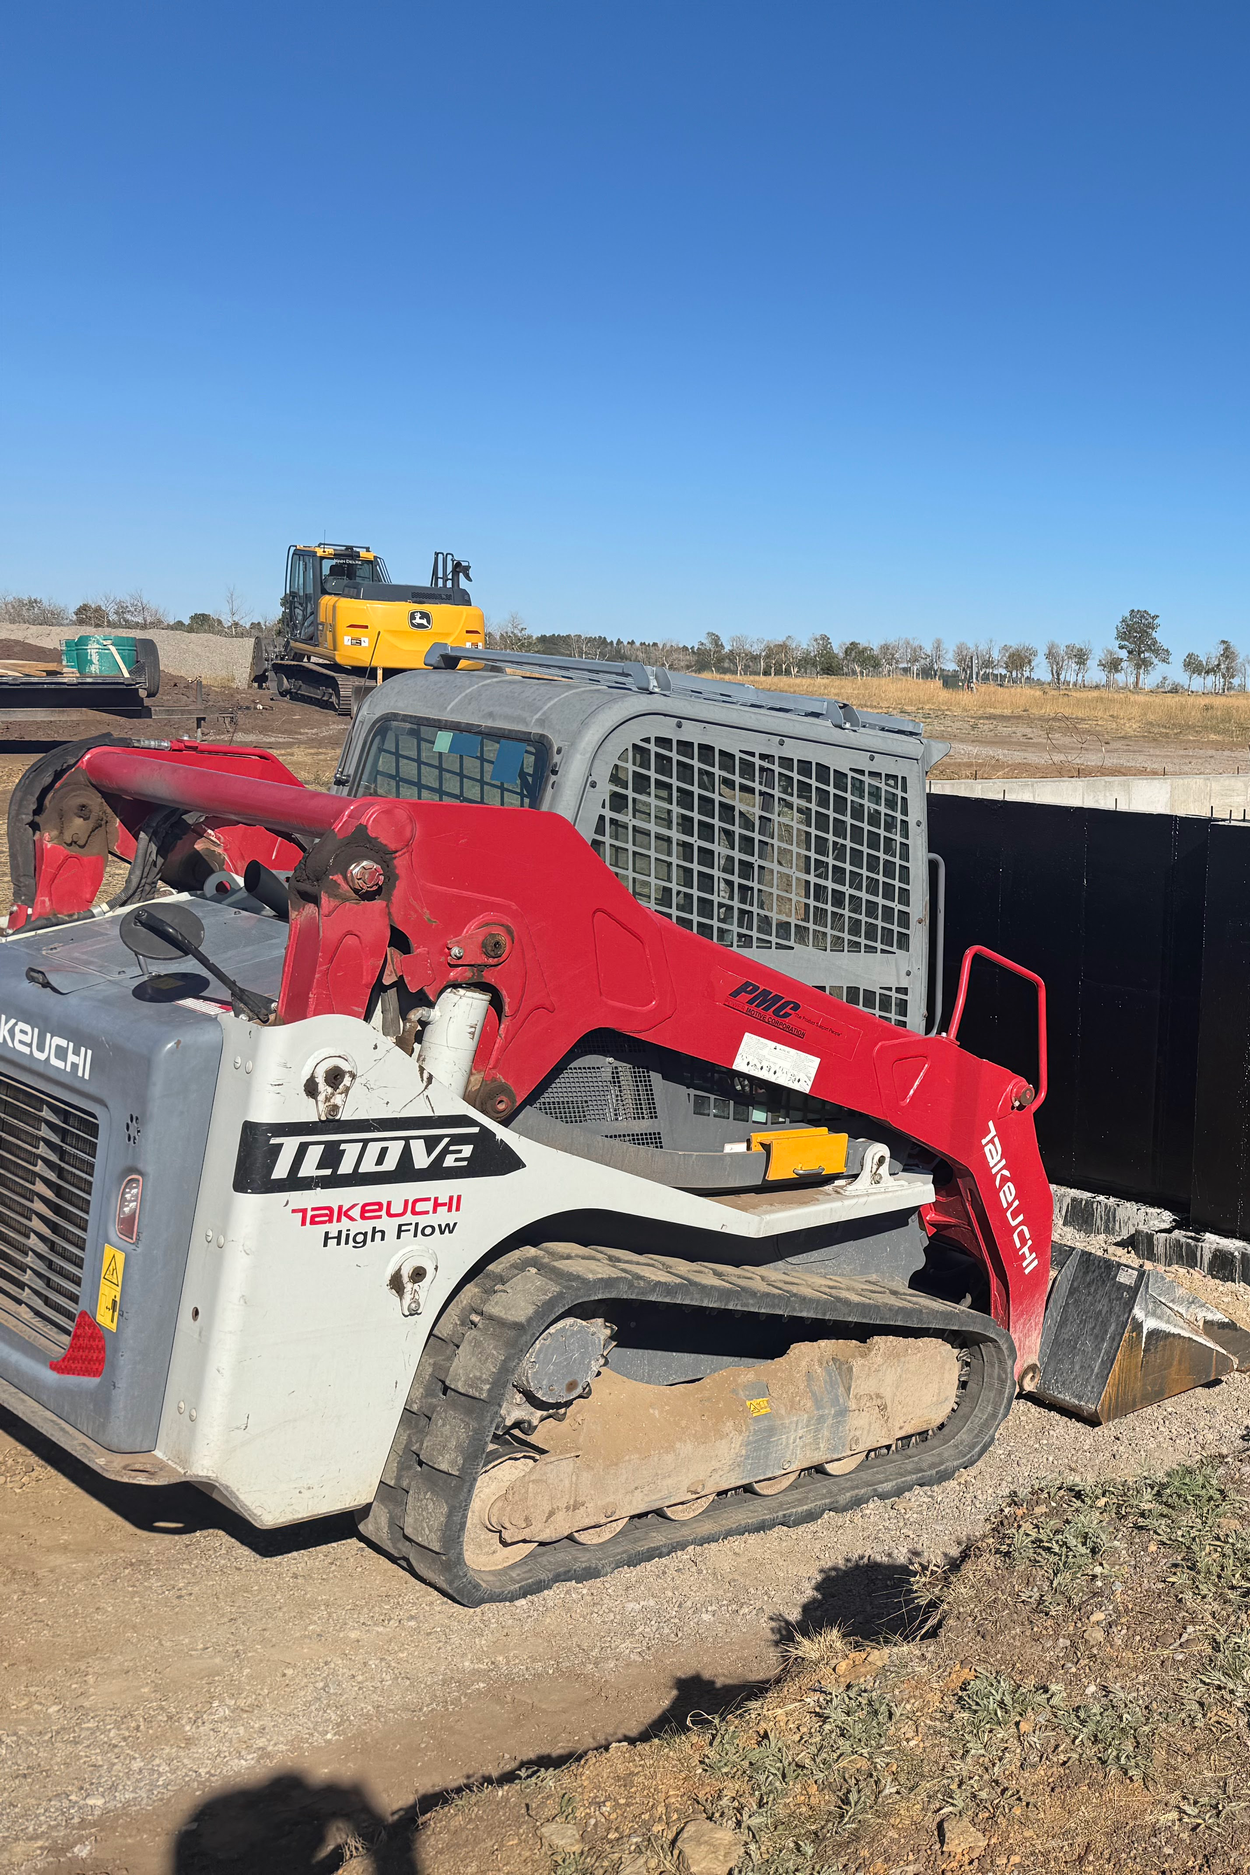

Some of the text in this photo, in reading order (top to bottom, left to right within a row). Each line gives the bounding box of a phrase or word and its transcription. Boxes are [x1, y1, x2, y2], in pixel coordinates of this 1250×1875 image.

[728, 980, 802, 1019] PMC
[746, 1007, 768, 1021] MOTIVE
[767, 1016, 806, 1037] CORPORATION
[0, 1014, 92, 1080] KeUCHI
[322, 1221, 458, 1249] High Flow
